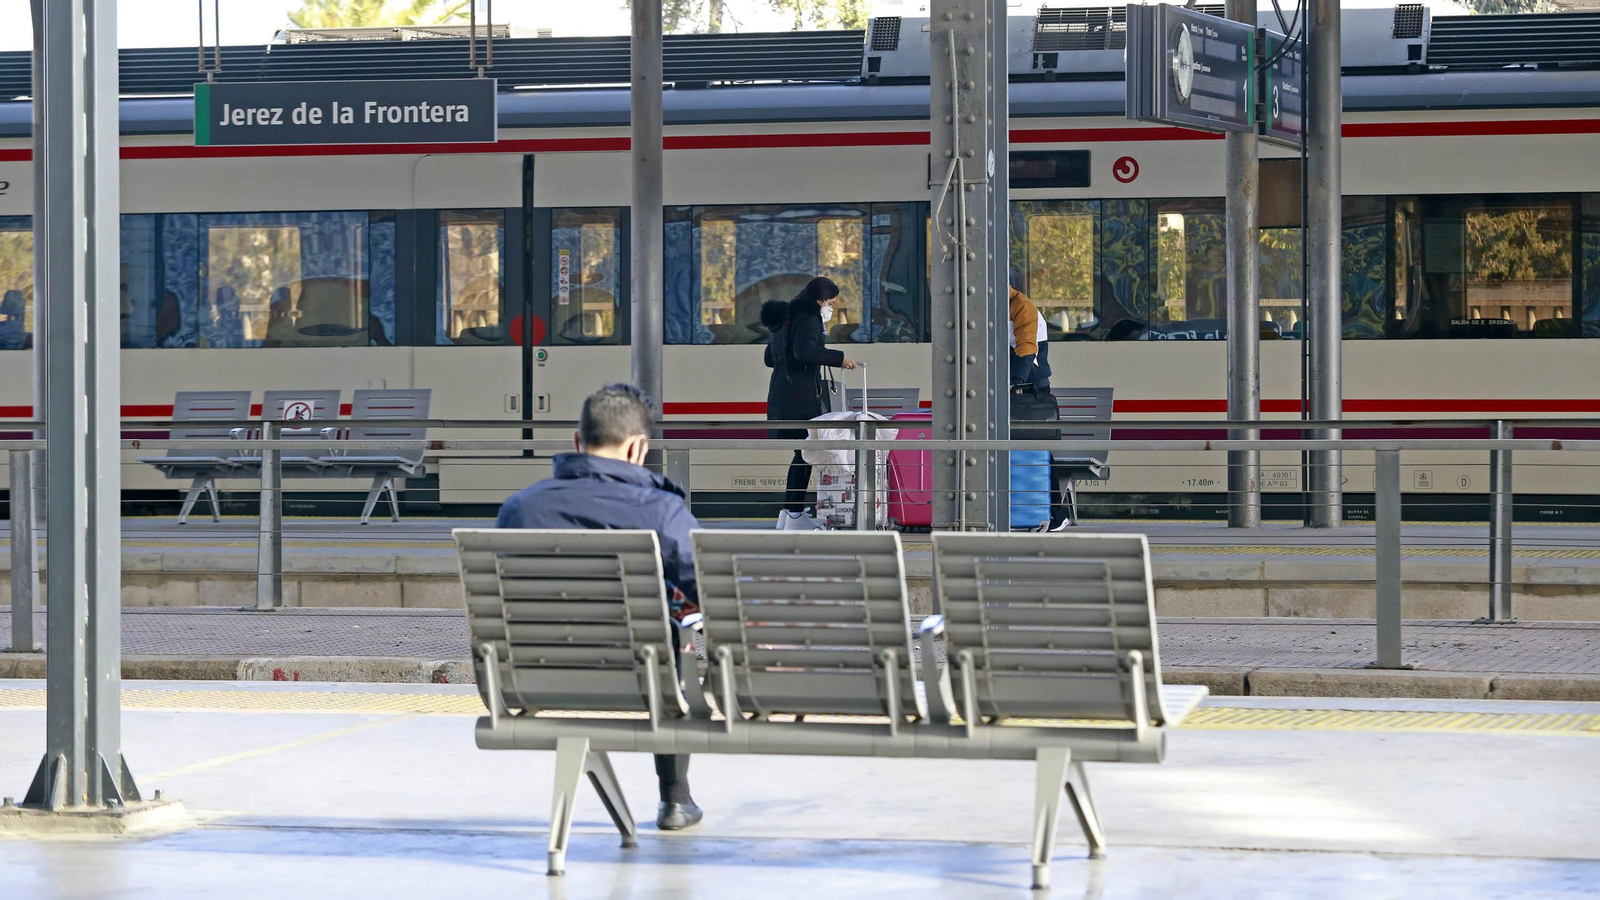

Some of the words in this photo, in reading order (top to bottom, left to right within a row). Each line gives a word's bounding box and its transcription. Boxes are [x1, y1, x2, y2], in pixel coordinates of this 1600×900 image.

[1243, 79, 1248, 113] 1
[1272, 85, 1279, 119] 3
[219, 103, 283, 127] Jerez
[292, 102, 323, 126] de
[332, 101, 354, 125] la
[364, 101, 470, 124] Frontera
[734, 478, 756, 486] FRENO
[1461, 478, 1467, 487] D
